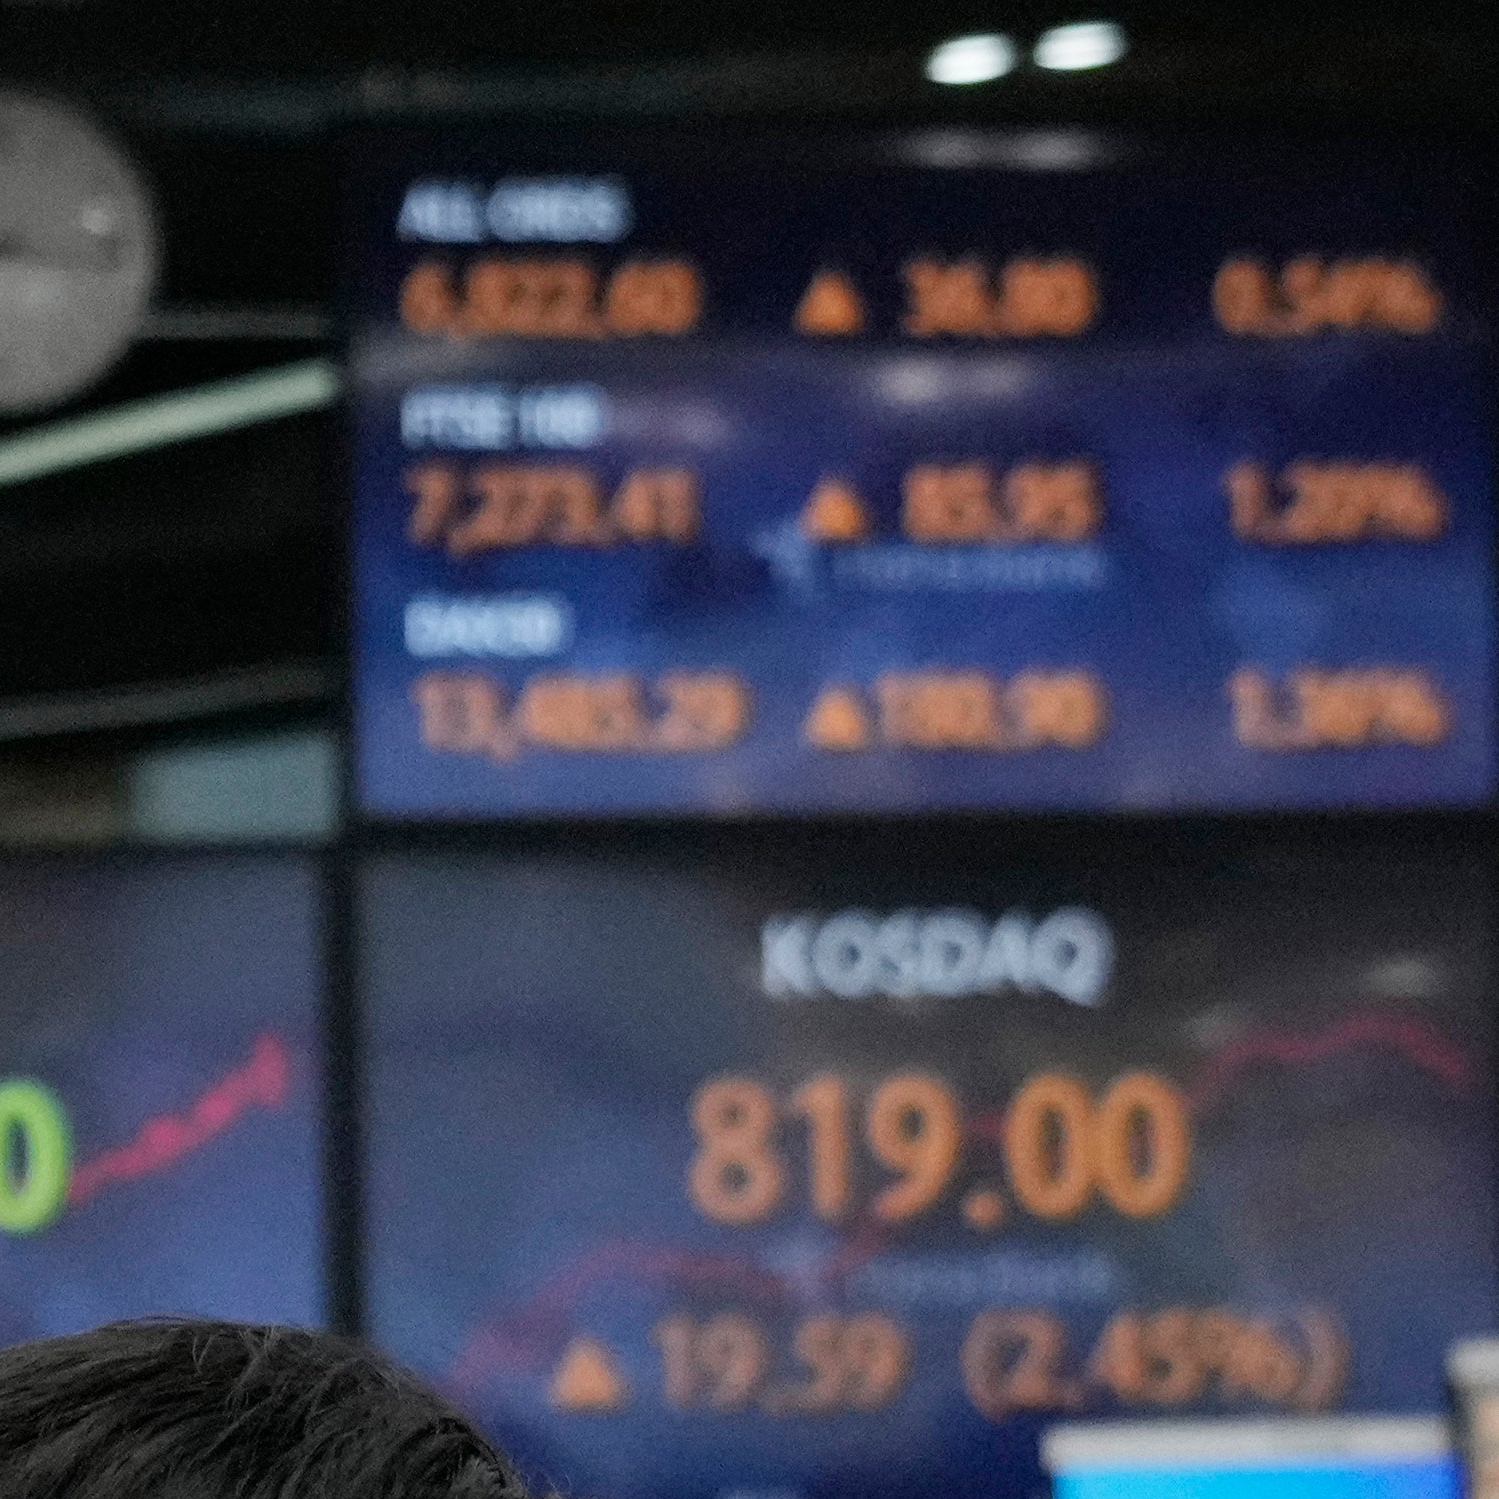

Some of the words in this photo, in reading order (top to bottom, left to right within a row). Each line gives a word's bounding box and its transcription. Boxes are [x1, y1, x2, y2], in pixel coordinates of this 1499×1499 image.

[762, 906, 1114, 1004] KOSDAQ
[688, 1070, 1190, 1228] 819.00
[655, 1312, 912, 1417] 19.59
[961, 1306, 1349, 1420] (2.45%)
